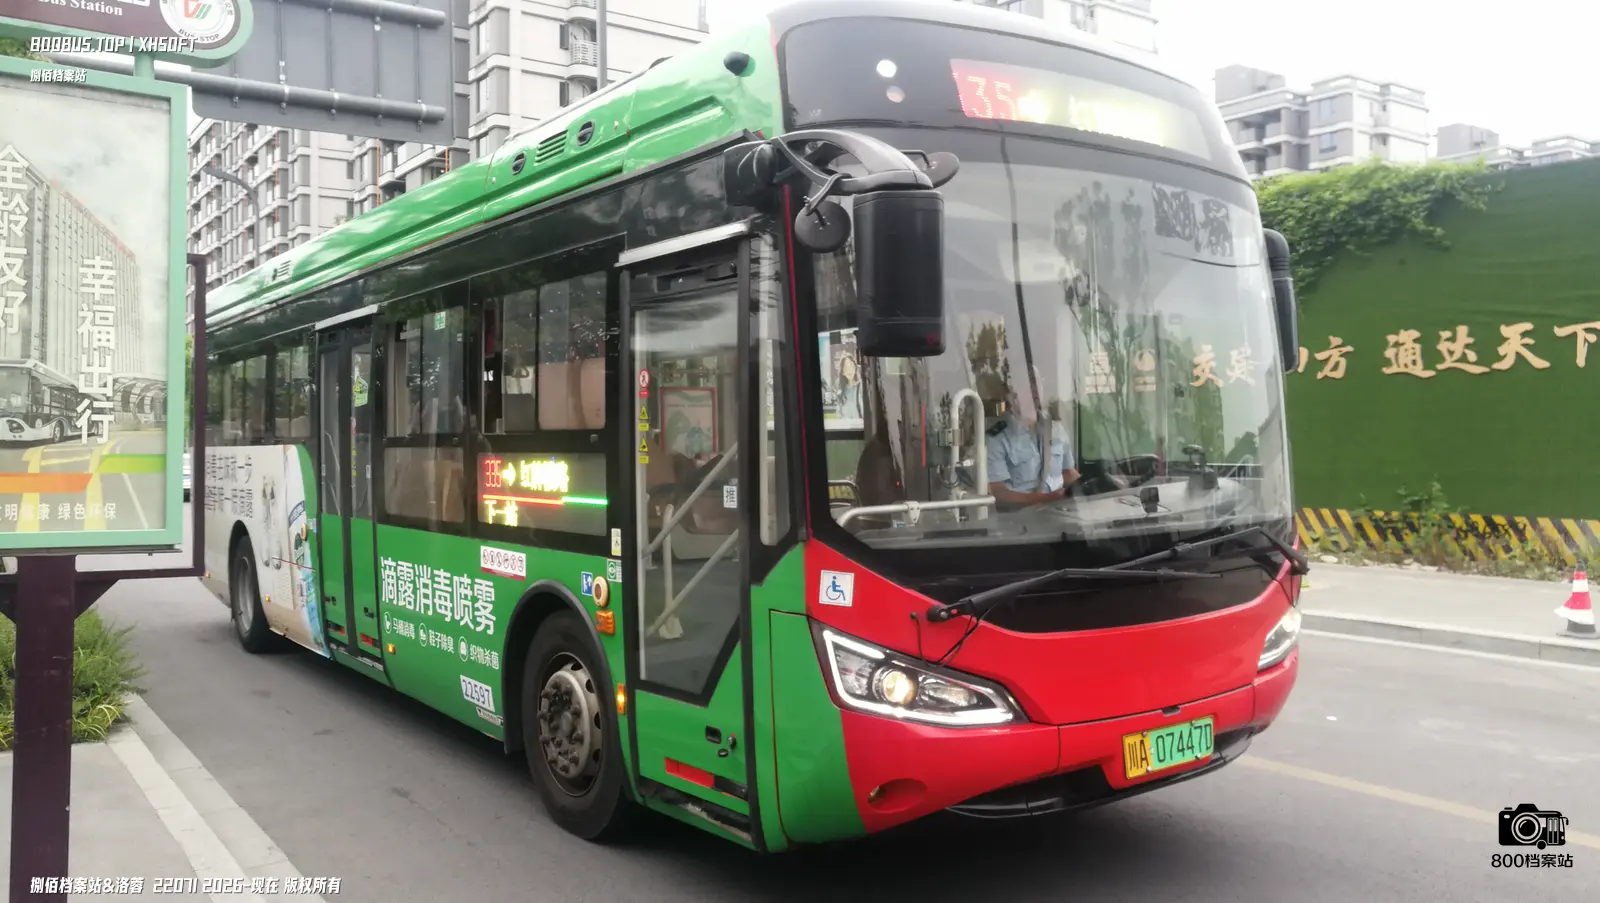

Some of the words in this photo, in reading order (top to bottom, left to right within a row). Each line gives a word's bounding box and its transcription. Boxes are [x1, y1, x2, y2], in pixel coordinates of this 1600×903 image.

[70, 0, 123, 16] Station
[199, 33, 220, 43] STOP
[76, 254, 117, 445] 幸福出行
[1382, 321, 1600, 379] 通达天下
[380, 556, 496, 636] 滴露消毒喷雾
[428, 629, 455, 654] 鞋子除臭
[469, 643, 499, 670] 织物杀菌
[462, 678, 492, 708] 22597
